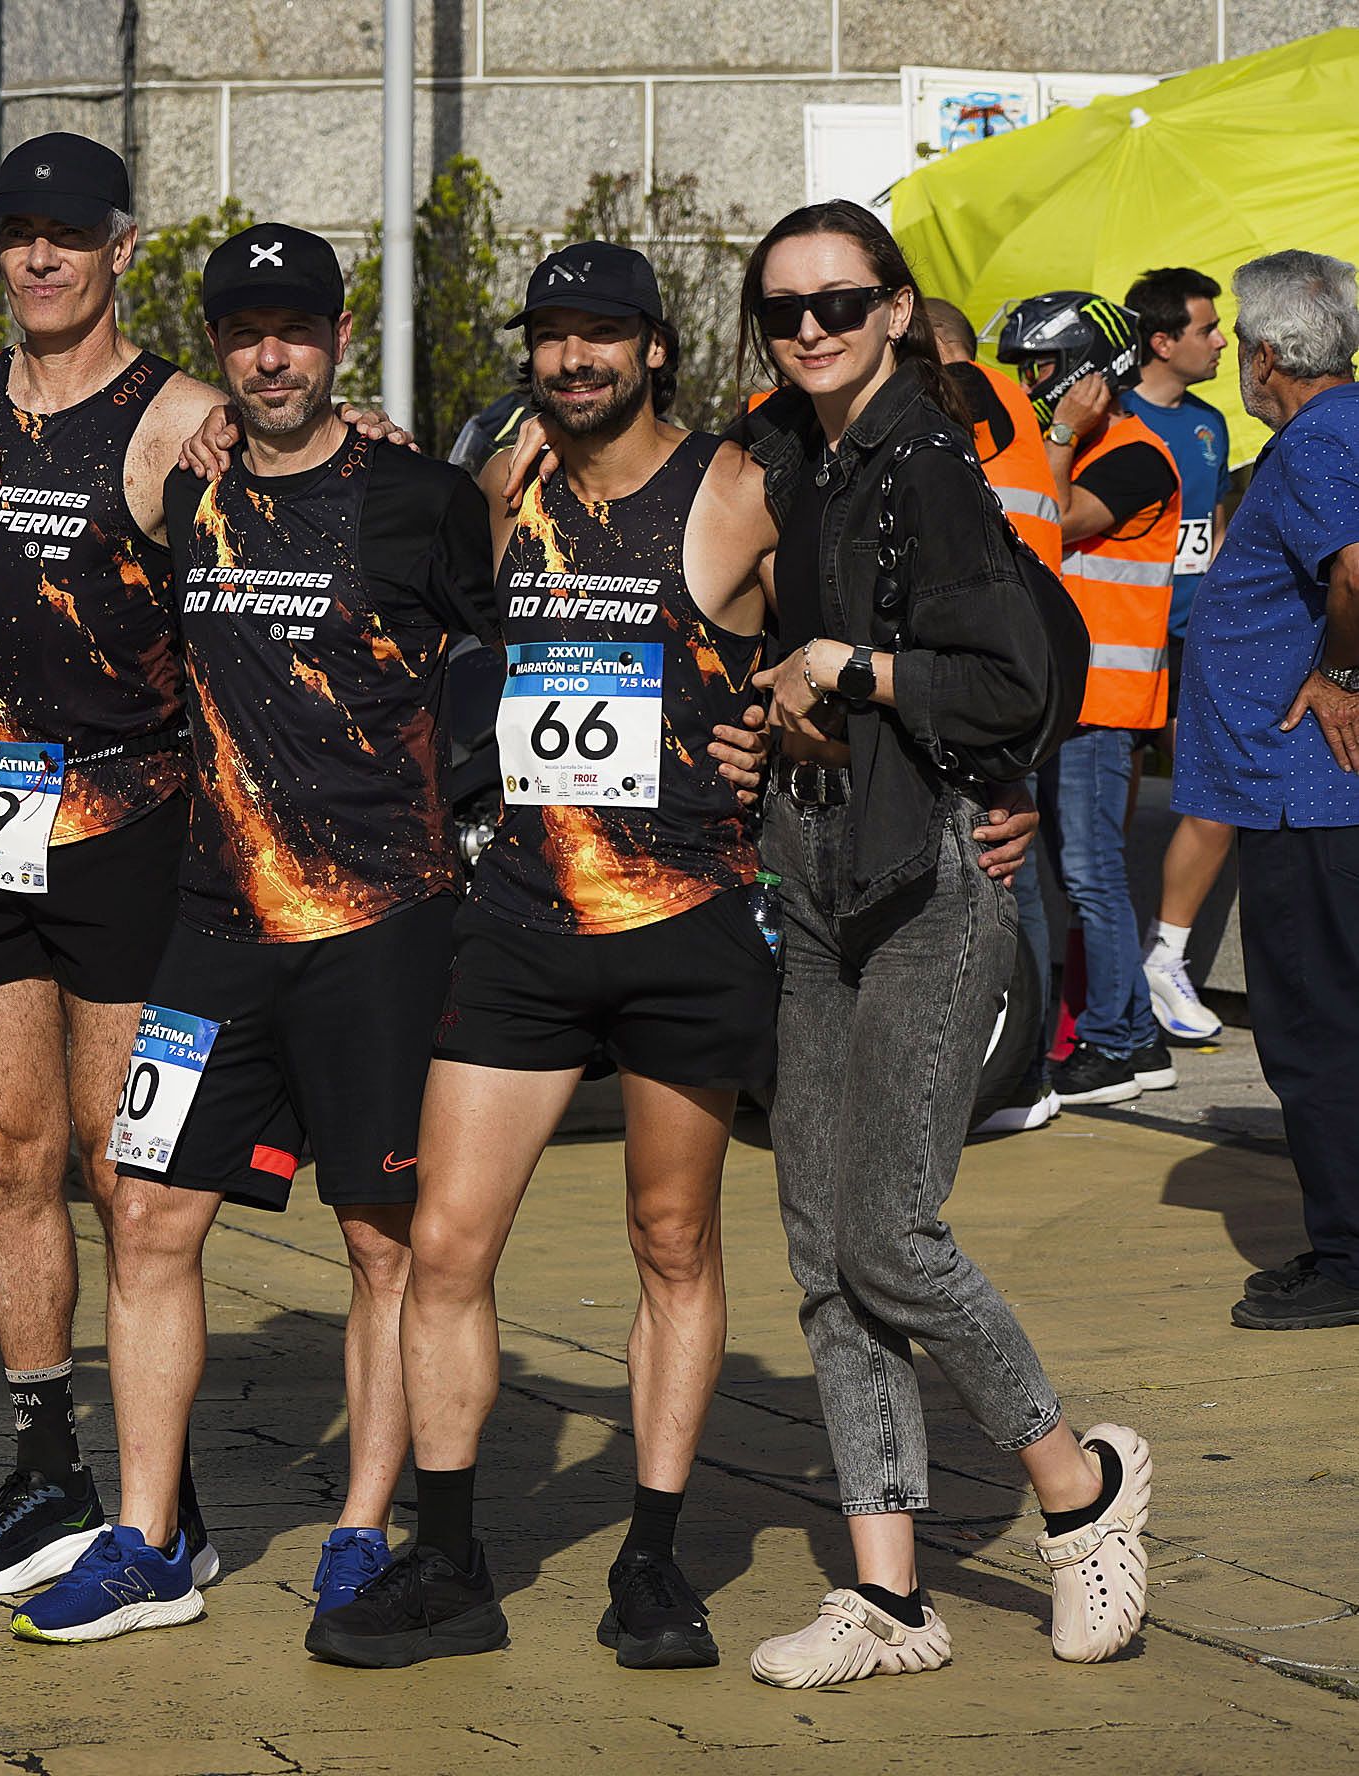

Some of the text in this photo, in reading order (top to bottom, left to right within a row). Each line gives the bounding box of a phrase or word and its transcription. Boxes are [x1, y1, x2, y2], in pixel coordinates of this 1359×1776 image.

[113, 364, 153, 406] OCDI
[340, 433, 368, 478] OCD
[41, 545, 71, 561] 25
[186, 568, 333, 589] OS CORREDORES
[509, 572, 662, 595] OS CORREDORES
[183, 591, 332, 618] DO INFERNO
[508, 596, 659, 625] DO INFERNO
[286, 625, 315, 641] 25
[546, 646, 594, 658] XXXVII
[515, 658, 644, 675] MARATÓN DE FÁTIMA
[543, 677, 590, 692] POIO
[619, 677, 662, 689] 7.5 KM
[531, 700, 619, 761] 66
[25, 774, 62, 786] 7.5 KM
[573, 774, 598, 783] FROIZ
[144, 1023, 194, 1047] FÁTIMA
[168, 1045, 208, 1064] 7.5 KM
